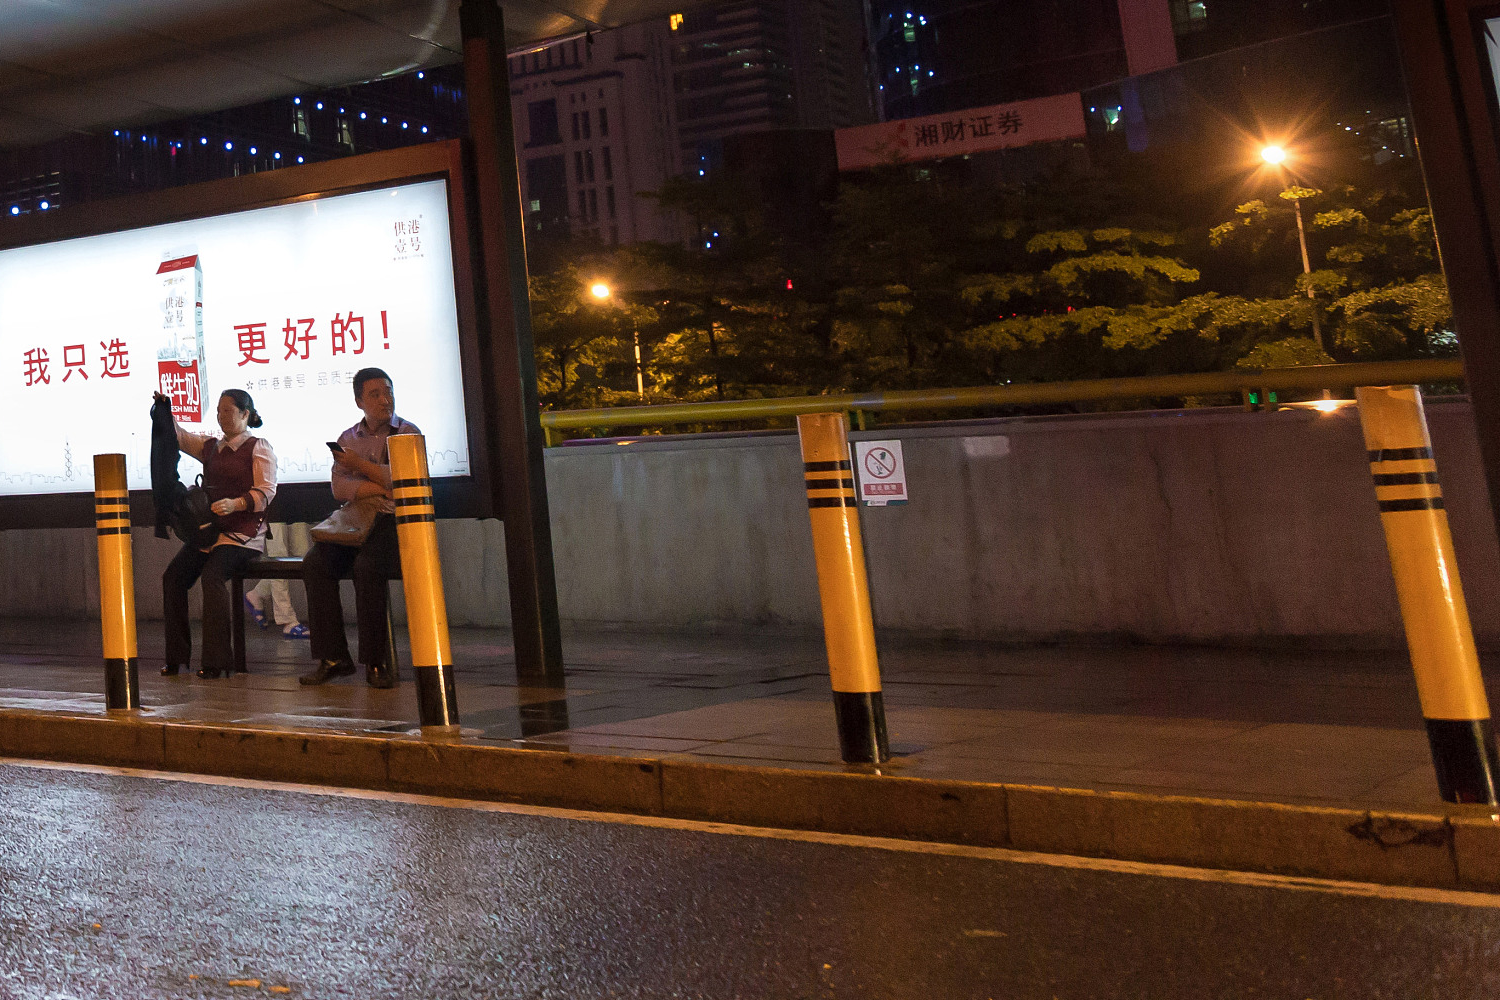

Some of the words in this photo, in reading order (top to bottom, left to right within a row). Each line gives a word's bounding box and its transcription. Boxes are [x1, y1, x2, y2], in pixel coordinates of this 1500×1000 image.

[914, 110, 1024, 148] 湘财证券
[23, 337, 131, 387] 我只选
[160, 372, 200, 406] 鲜牛奶
